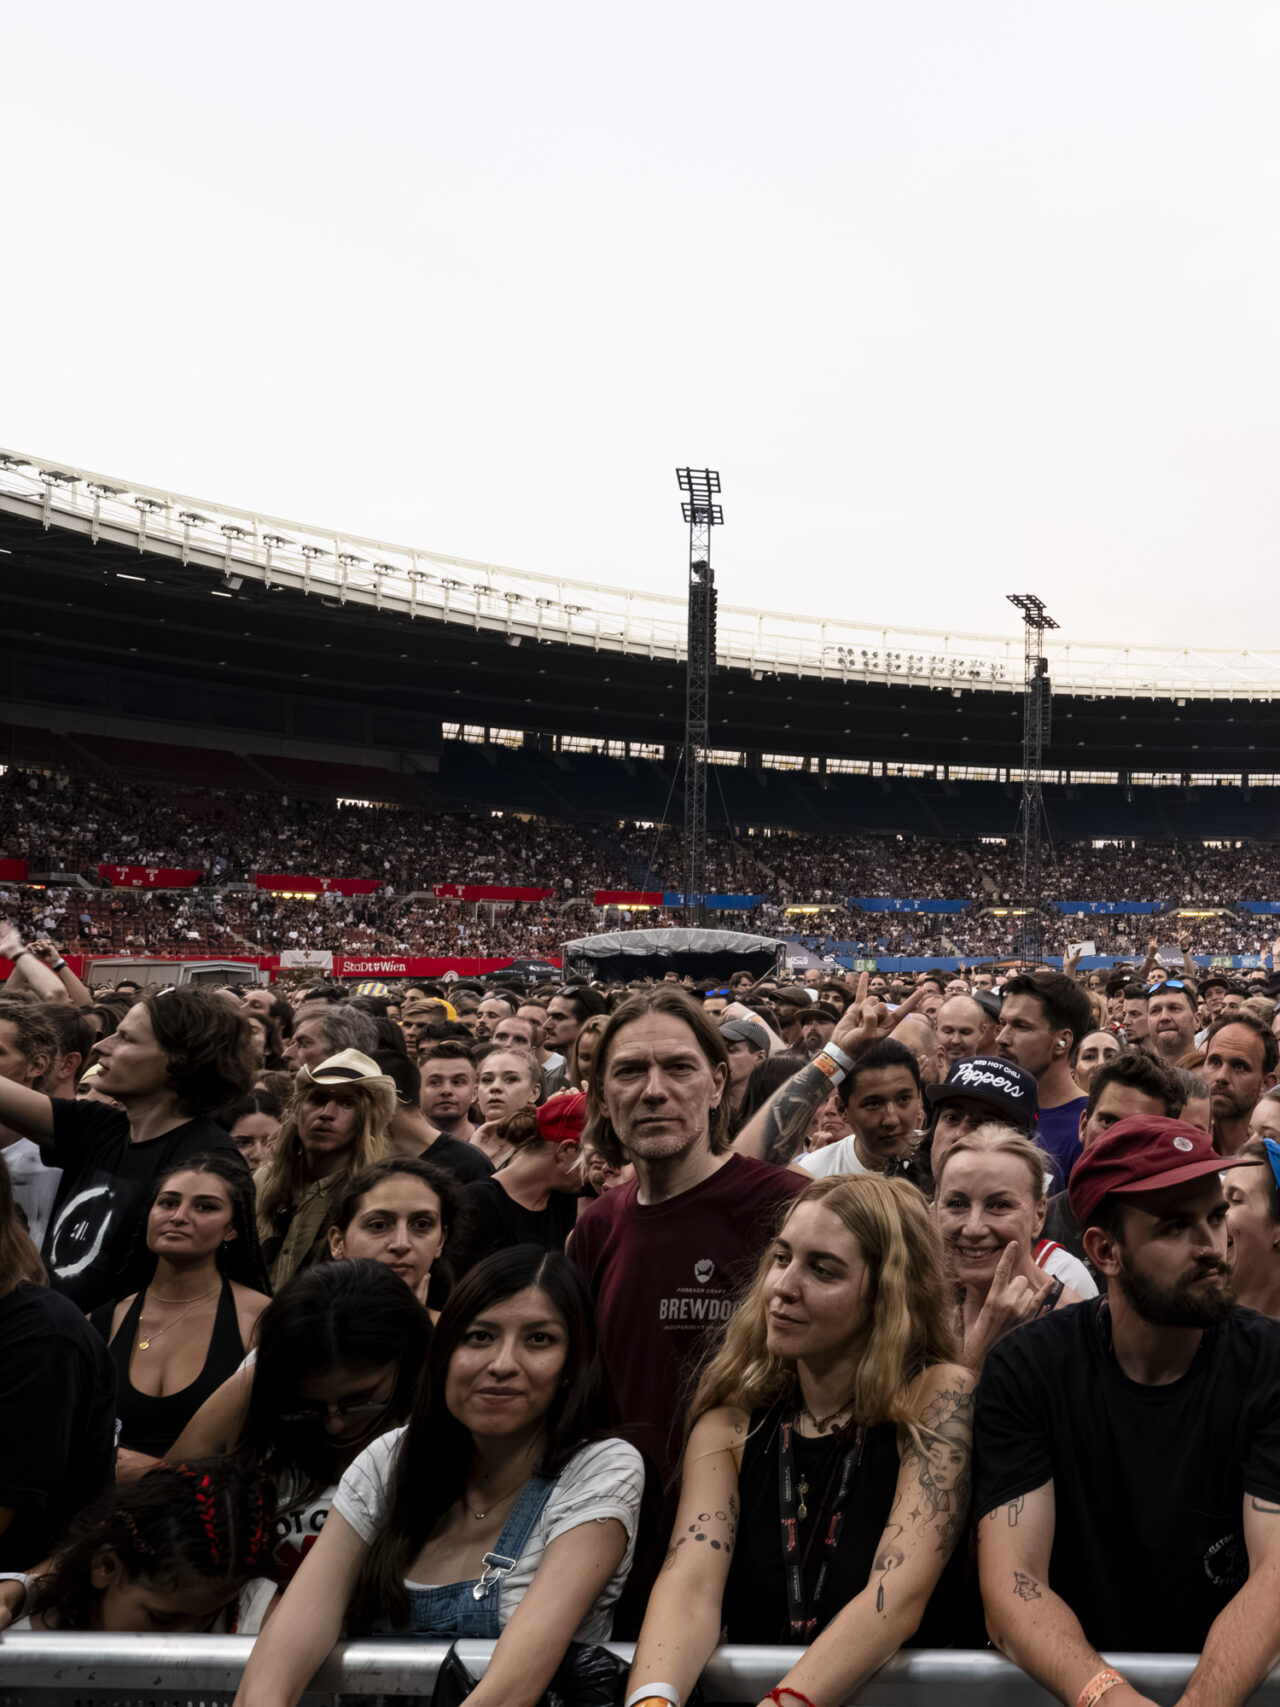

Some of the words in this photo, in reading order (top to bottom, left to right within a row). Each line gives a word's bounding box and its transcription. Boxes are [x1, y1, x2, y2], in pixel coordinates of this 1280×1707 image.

[380, 960, 406, 972] Wien
[987, 1061, 1004, 1071] HOT
[1003, 1066, 1021, 1080] CHILI
